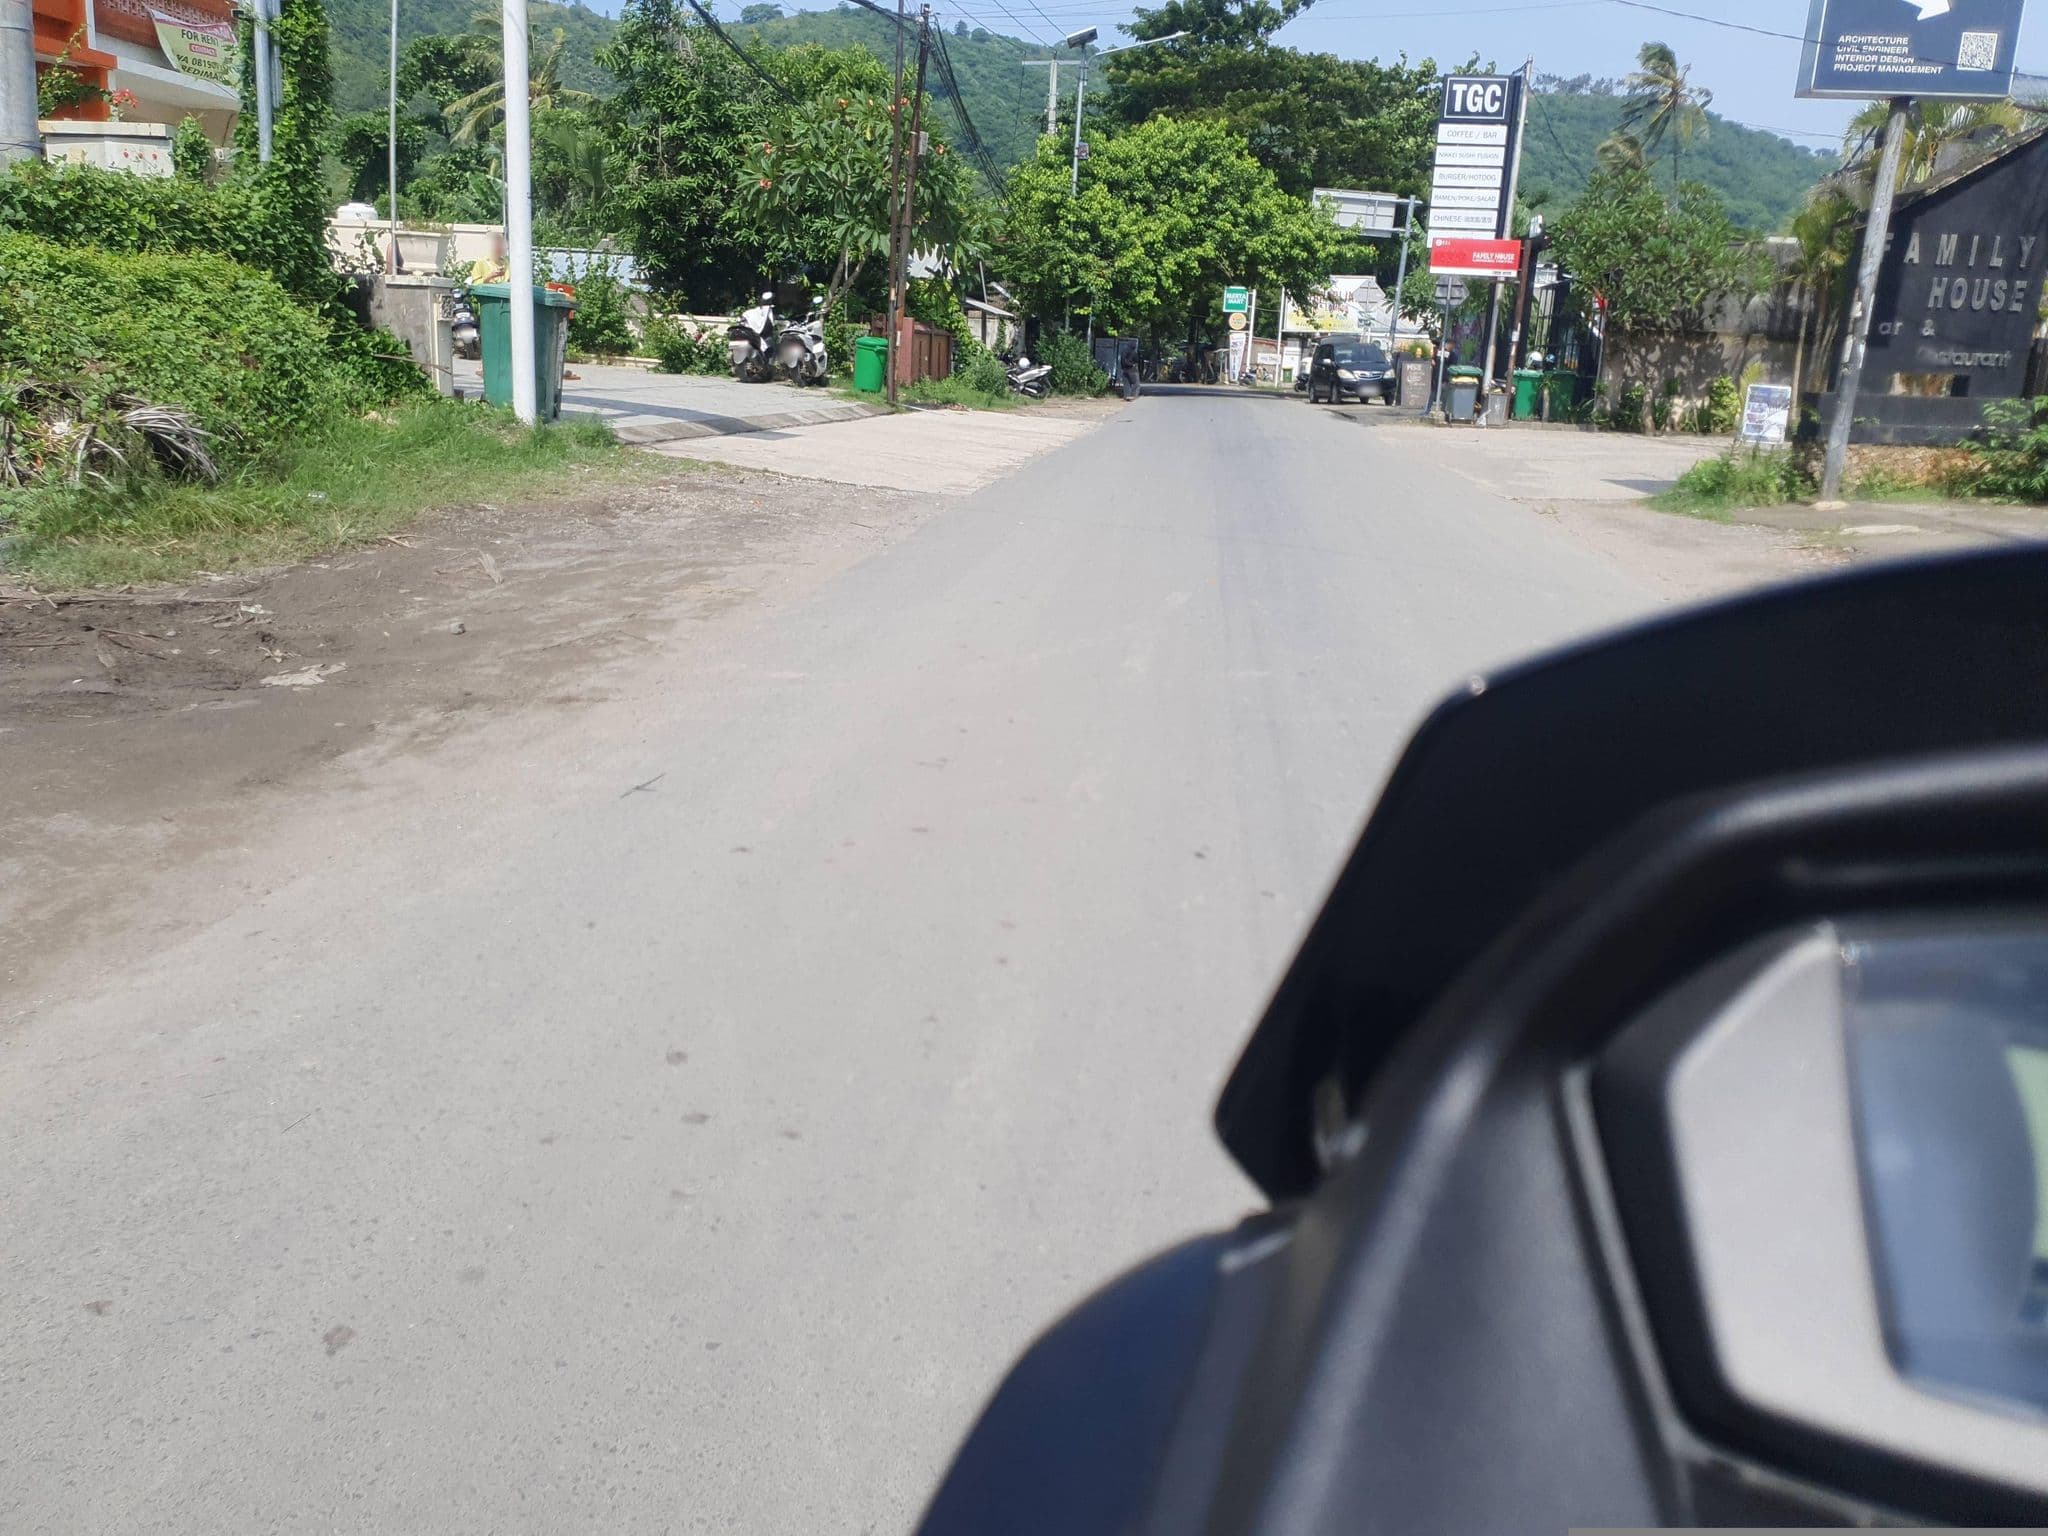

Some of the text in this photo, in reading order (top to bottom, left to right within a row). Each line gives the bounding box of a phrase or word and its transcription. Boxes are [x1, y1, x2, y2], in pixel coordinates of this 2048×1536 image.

[181, 29, 199, 41] FOR
[1838, 35, 1909, 45] ARCHITECTURE
[1837, 45, 1909, 55] CIVIL ENGINEER
[1835, 54, 1915, 64] INTERIOR DESIGN
[1833, 63, 1944, 74] PROJECT MANAGEMENT
[1452, 83, 1502, 113] TGC
[1447, 130, 1474, 138] COFFEE
[1433, 215, 1462, 223] CHINESE
[1472, 252, 1493, 260] FAMILY
[1927, 277, 2028, 312] HOUSE
[1921, 319, 1936, 336] &
